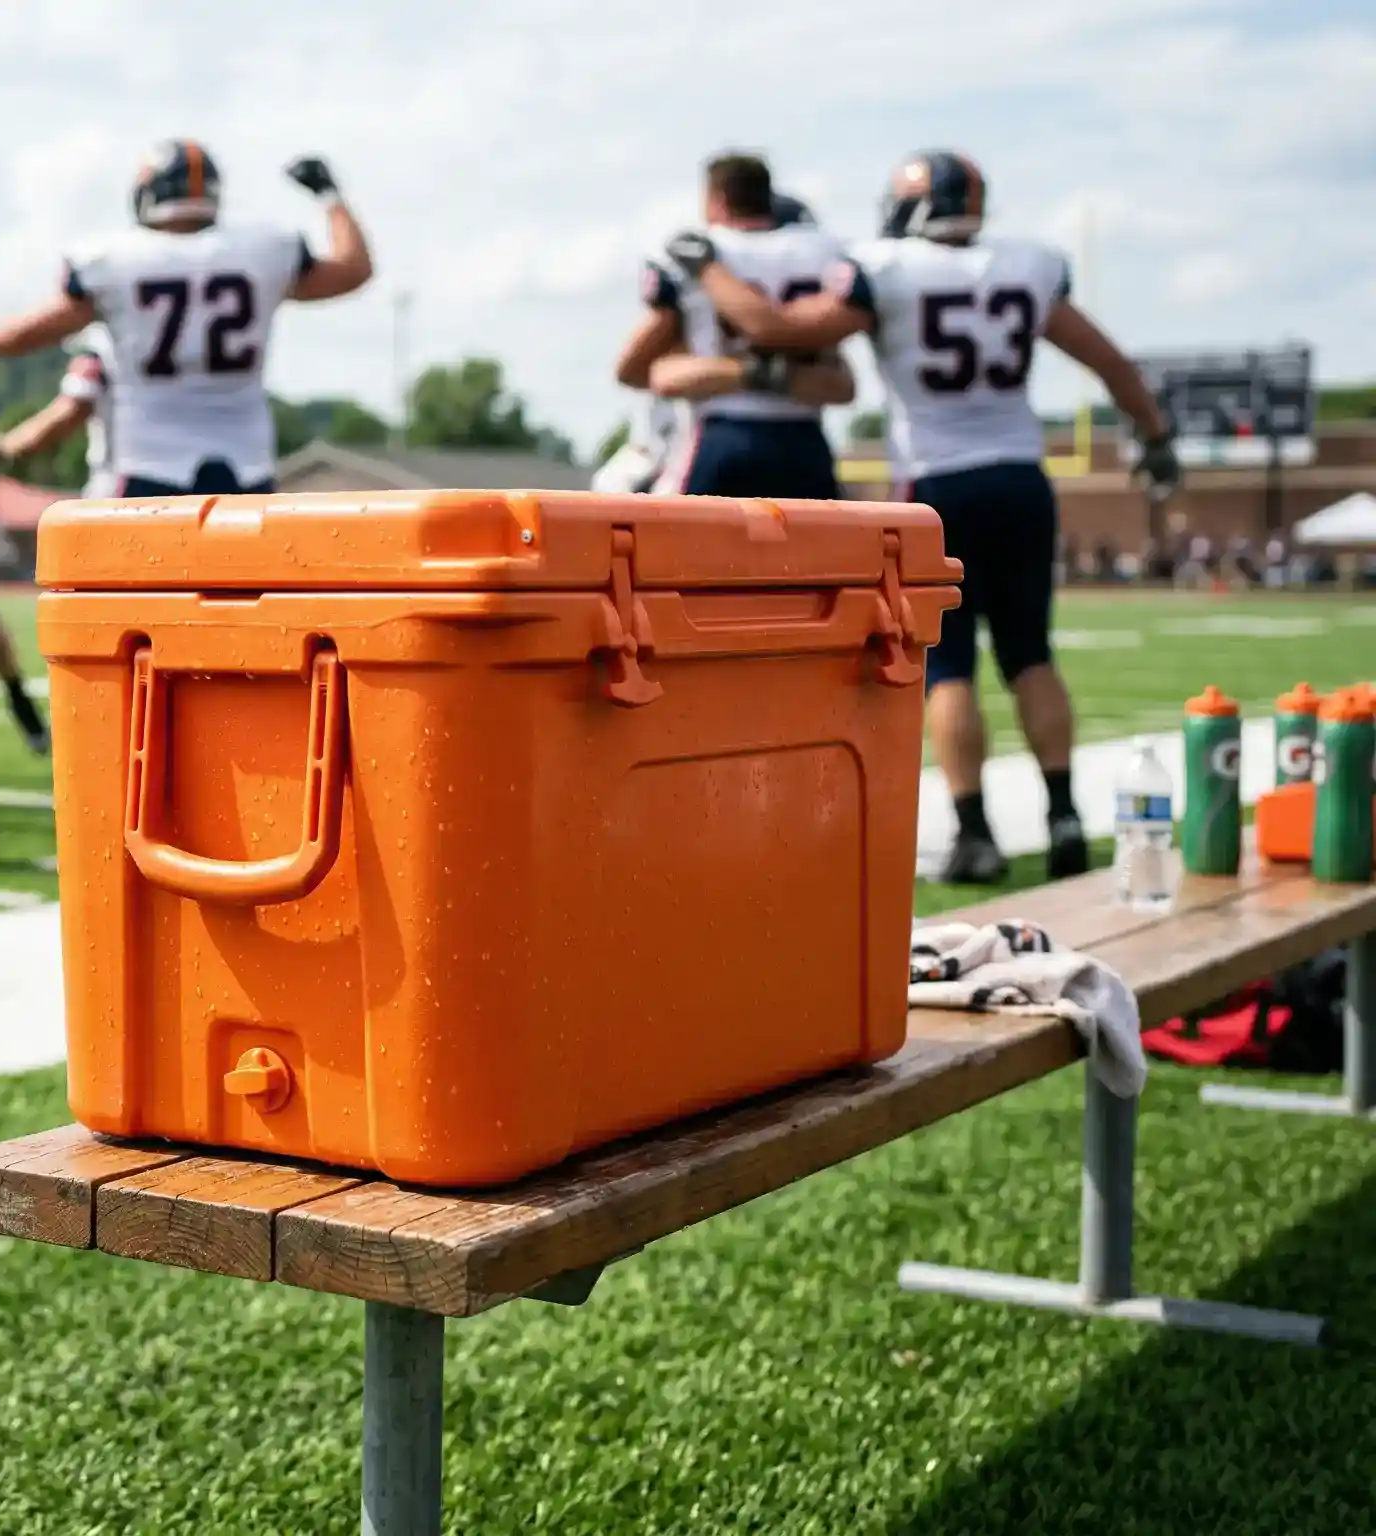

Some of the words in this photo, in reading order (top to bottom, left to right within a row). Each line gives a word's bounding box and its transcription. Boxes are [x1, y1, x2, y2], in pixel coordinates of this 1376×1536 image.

[136, 272, 259, 378] 72
[918, 287, 1035, 392] 53
[1277, 735, 1312, 777] G
